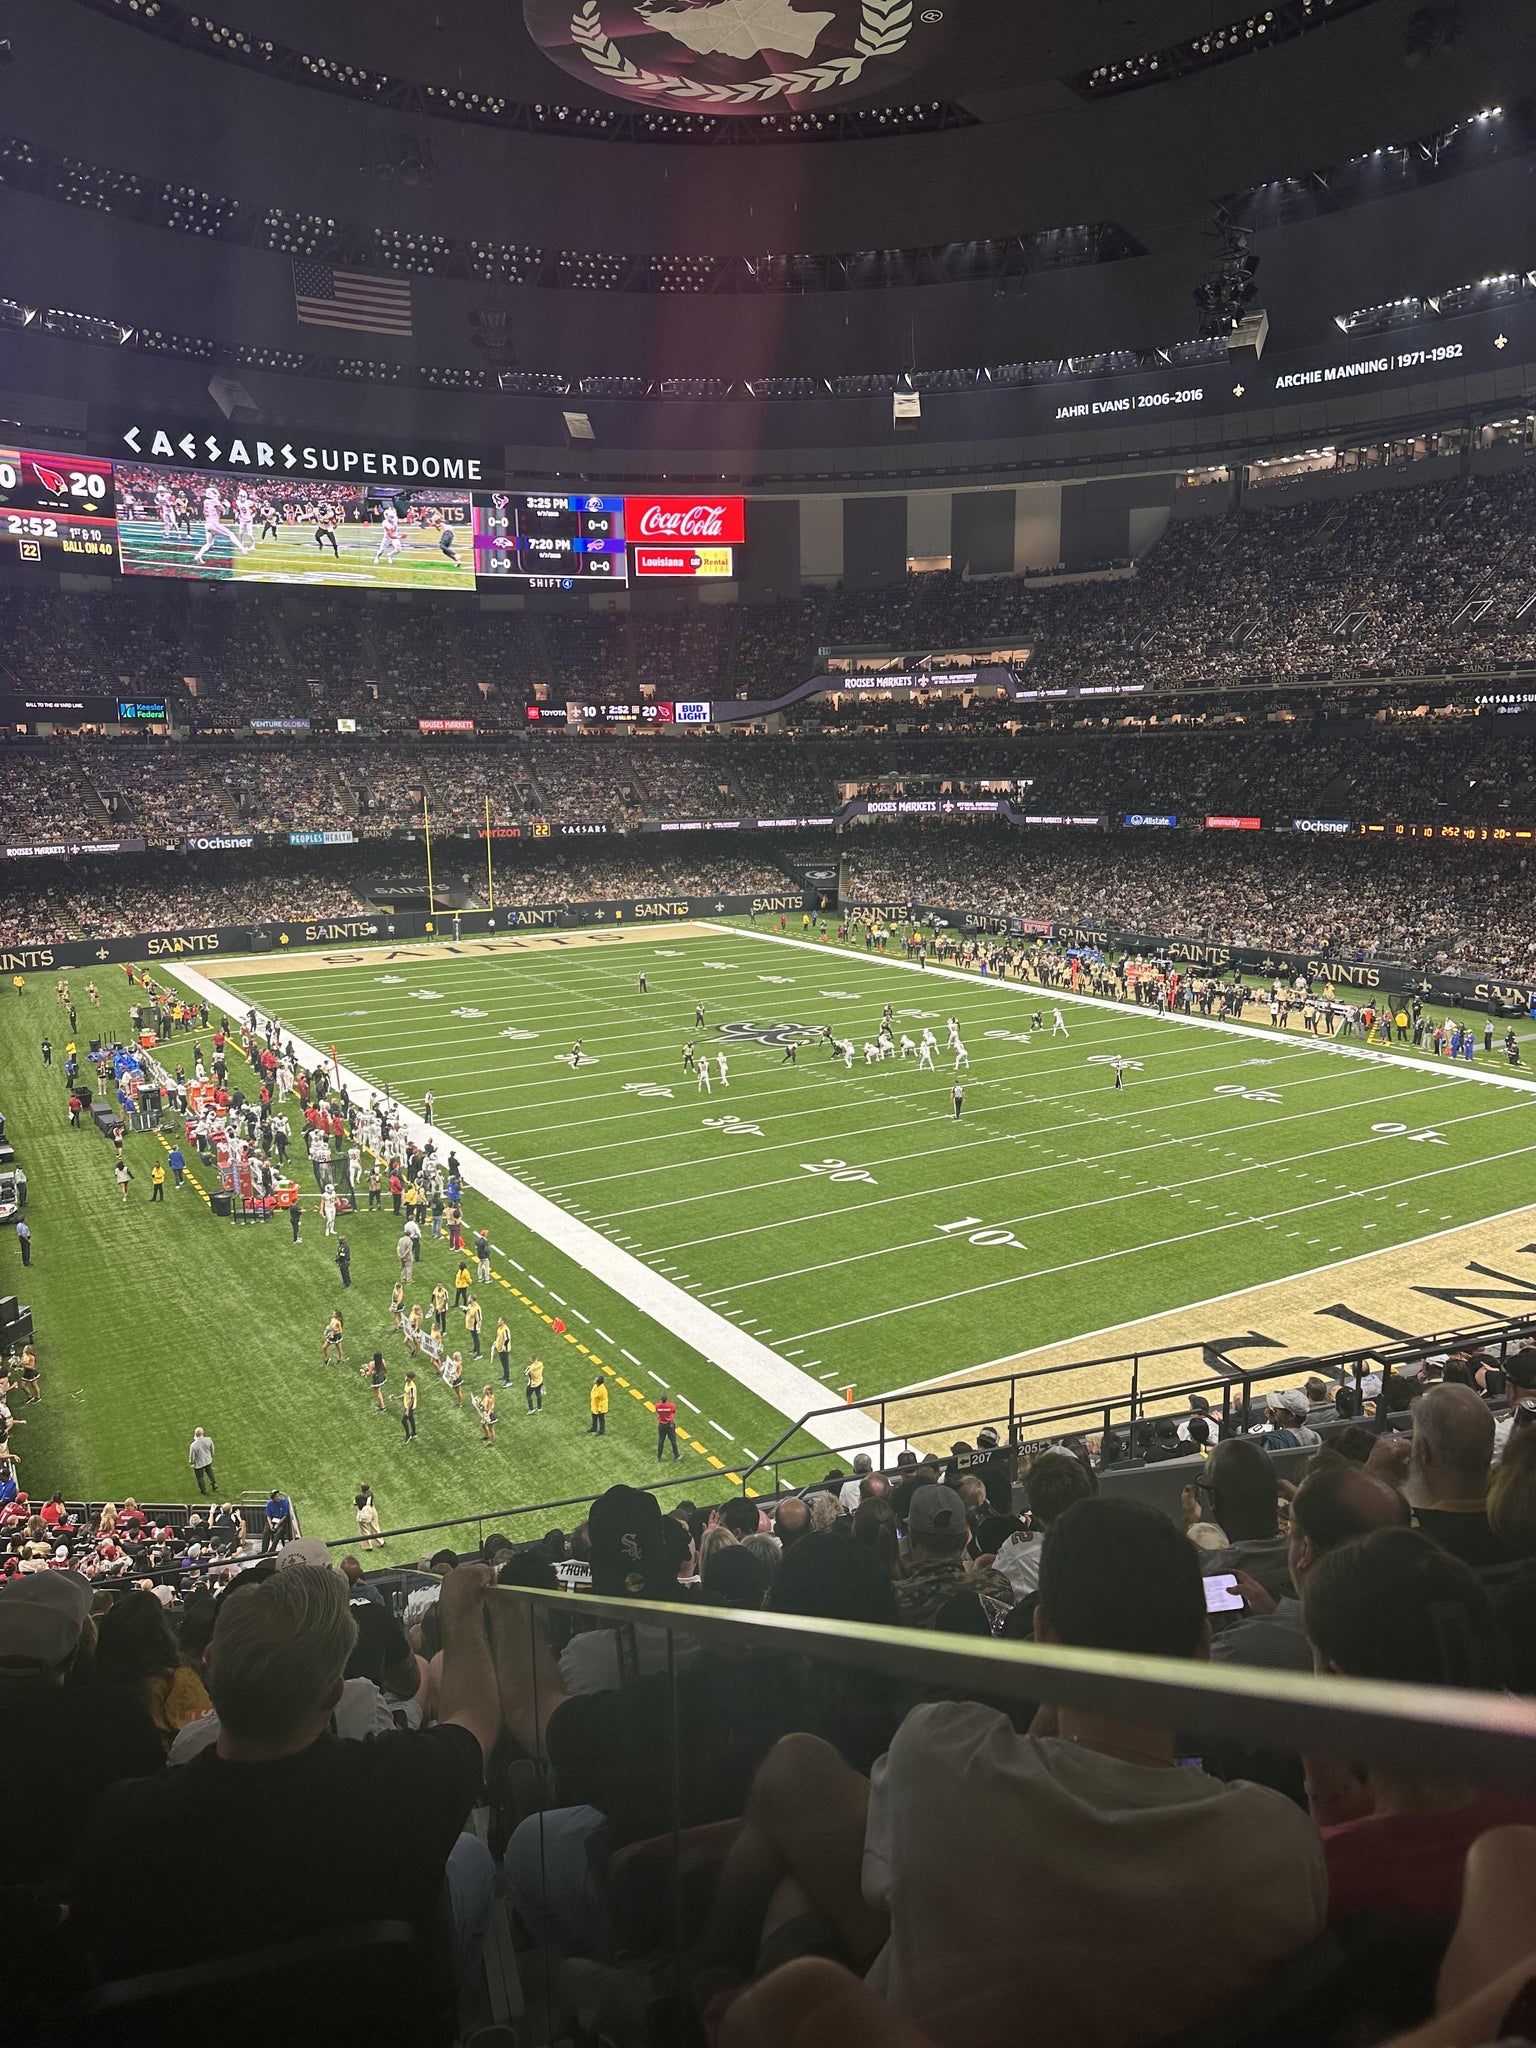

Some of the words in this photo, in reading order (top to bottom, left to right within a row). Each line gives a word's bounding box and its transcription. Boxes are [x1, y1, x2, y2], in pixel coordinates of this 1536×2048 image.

[1275, 370, 1322, 389] ARCHIE
[1324, 358, 1389, 383] MANNING
[1397, 345, 1463, 368] 1971-1982
[1055, 402, 1089, 419] JAHRI
[1092, 397, 1130, 414] EVANS
[1137, 389, 1203, 408] 2006-2016
[123, 426, 297, 469] CAESARS
[303, 447, 482, 481] SUPERDOME
[69, 472, 106, 499] 20
[527, 497, 552, 509] 3:25
[553, 498, 569, 509] PM
[488, 517, 509, 527] 0-0
[588, 520, 609, 530] 0-0
[640, 505, 727, 536] Coca-Cola
[7, 515, 58, 538] 2:52
[69, 528, 81, 539] 1ST
[82, 530, 89, 540] &
[90, 530, 101, 541] 10
[62, 540, 85, 553] BALL
[85, 543, 98, 554] ON
[99, 544, 112, 556] 40
[529, 539, 554, 550] 7:20
[555, 539, 571, 550] PM
[23, 544, 38, 557] 22
[490, 558, 511, 568] 0-0
[590, 561, 610, 571] 0-0
[642, 556, 684, 567] Louisiana
[1395, 667, 1425, 677] SAINTS
[1462, 663, 1495, 673] SAINTS
[1271, 675, 1299, 683] SAINTS
[1332, 671, 1361, 680] SAINTS
[845, 677, 875, 688] ROUSES
[877, 676, 912, 687] MARKETS
[1214, 679, 1240, 687] SAINTS
[1474, 694, 1522, 704] CAESARS
[137, 703, 164, 711] Keesler
[582, 706, 597, 717] 10
[609, 706, 630, 714] 2:52
[642, 706, 657, 717] 20
[682, 705, 704, 713] BUD
[678, 712, 707, 720] LIGHT
[213, 718, 241, 726] SAINTS
[867, 802, 897, 813] ROUSES
[899, 801, 936, 812] MARKETS
[1143, 817, 1170, 825] Allstate
[1301, 820, 1348, 832] Ochsner
[477, 827, 520, 838] verizon
[535, 825, 548, 835] 22
[561, 825, 607, 834] CAESARS
[1360, 824, 1366, 833] 3
[1395, 825, 1404, 834] 10
[1412, 827, 1416, 835] 1
[1424, 828, 1432, 837] 10
[1441, 827, 1460, 836] 2:52
[1464, 829, 1475, 839] 40
[1494, 828, 1506, 838] 20
[290, 834, 323, 843] PEOPLES
[325, 832, 352, 842] HEALTH
[1481, 830, 1487, 839] 3
[147, 838, 179, 846] SAINTS
[197, 837, 252, 849] Ochsner
[6, 847, 33, 856] ROUSES
[374, 883, 450, 895] SAINTS
[752, 896, 803, 912] SAINTS
[634, 902, 689, 918] SAINTS
[853, 906, 908, 920] SAINTS
[306, 922, 371, 941] SAINTS
[1059, 927, 1107, 943] SAINTS
[148, 934, 219, 954] SAINTS
[322, 933, 624, 964] SAINTS
[1169, 942, 1230, 965] SAINTS
[1307, 961, 1380, 987] SAINTS
[621, 1081, 669, 1098] 40
[1213, 1084, 1280, 1101] 20
[701, 1115, 760, 1136] 30
[1370, 1122, 1444, 1145] 10
[800, 1158, 871, 1183] 20
[280, 1193, 289, 1203] G
[933, 1215, 1016, 1247] 10
[1017, 1442, 1038, 1456] 205
[971, 1451, 992, 1465] 207
[560, 1563, 591, 1577] THOM
